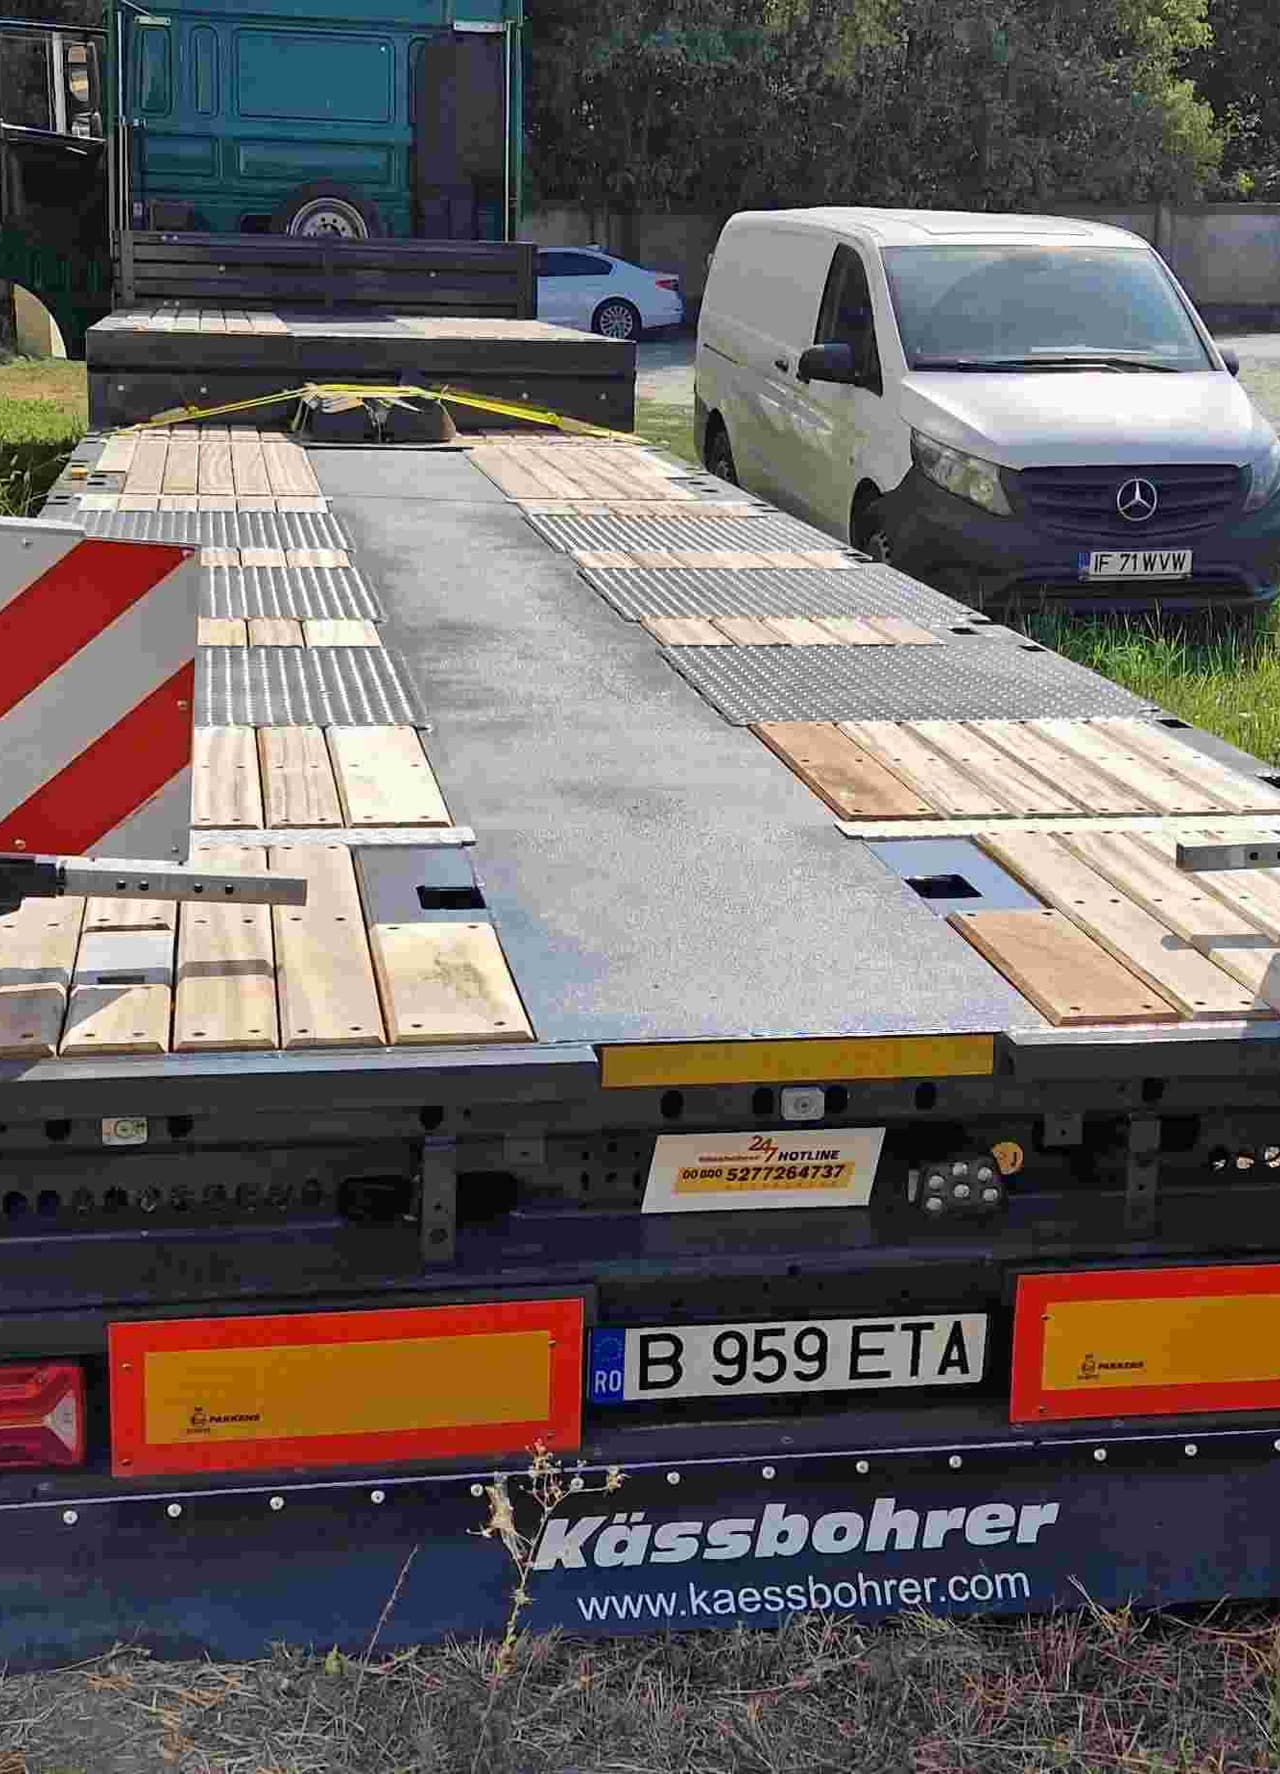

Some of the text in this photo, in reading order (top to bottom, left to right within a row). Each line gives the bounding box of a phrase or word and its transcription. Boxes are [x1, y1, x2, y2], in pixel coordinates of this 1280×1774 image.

[1094, 552, 1186, 572] IF 71 WVW
[725, 1164, 845, 1182] 5277264737
[778, 1150, 840, 1161] HOTLINE
[594, 1320, 971, 1394] RO B 959 ETA
[533, 1497, 1059, 1571] Kässbohrer
[577, 1569, 1030, 1620] www.kaessbohrer.com
